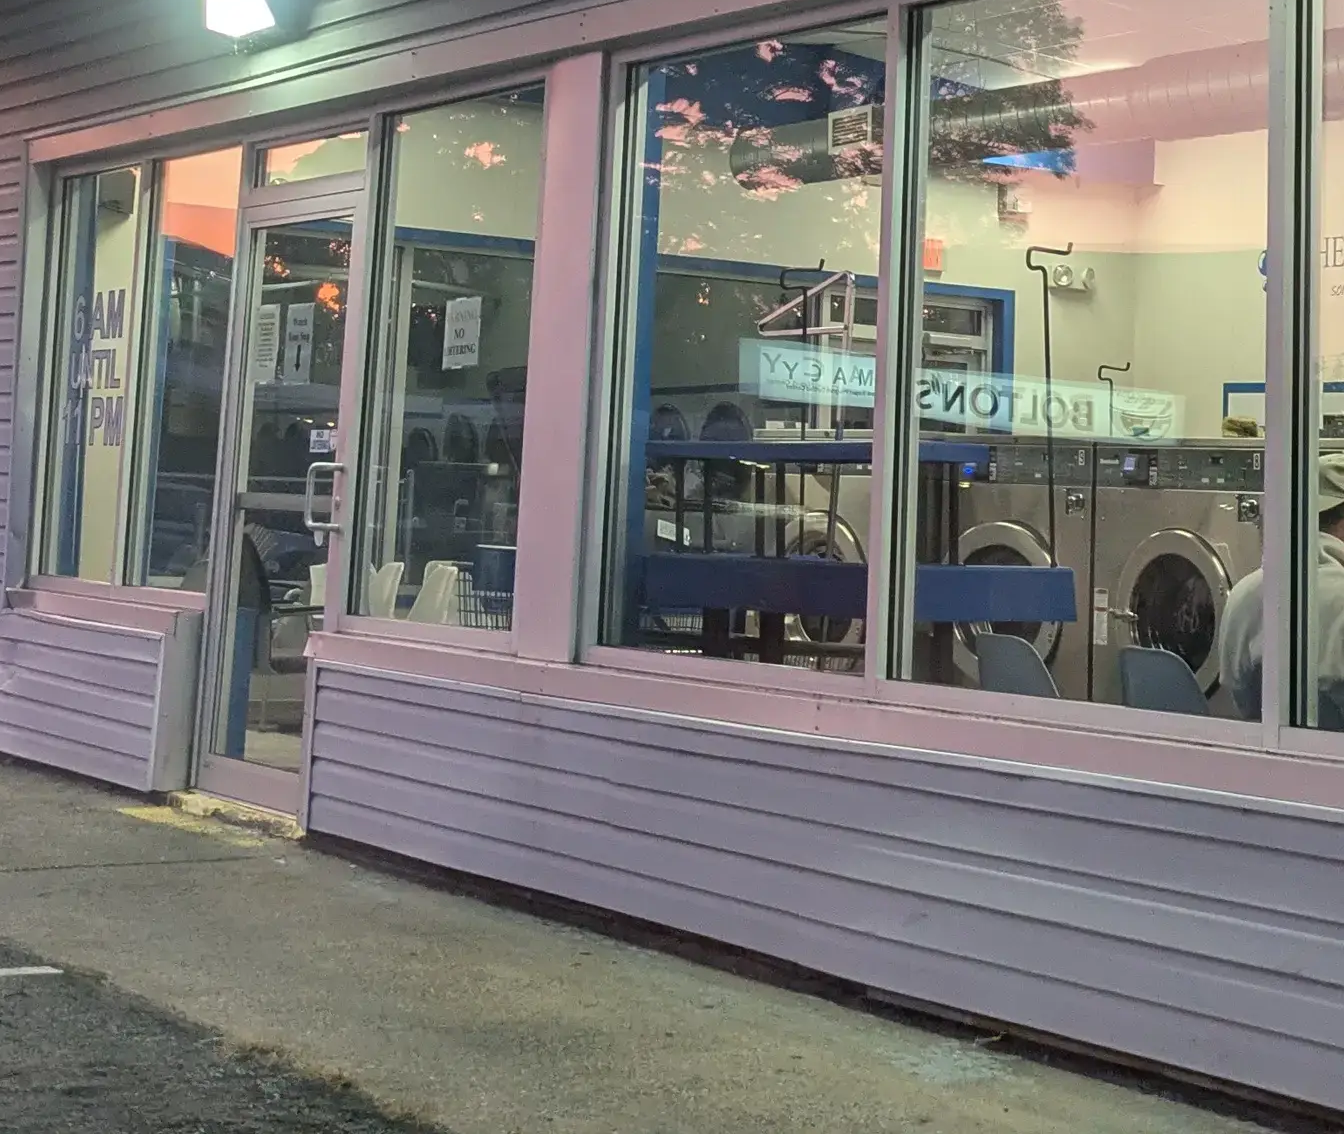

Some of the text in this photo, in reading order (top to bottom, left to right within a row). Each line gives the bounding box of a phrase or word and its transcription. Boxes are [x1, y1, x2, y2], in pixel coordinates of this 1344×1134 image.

[1320, 235, 1344, 269] HE
[74, 289, 126, 341] 6 AM
[454, 328, 464, 339] NO
[70, 348, 121, 390] UNTIL
[63, 396, 124, 446] 11 PM
